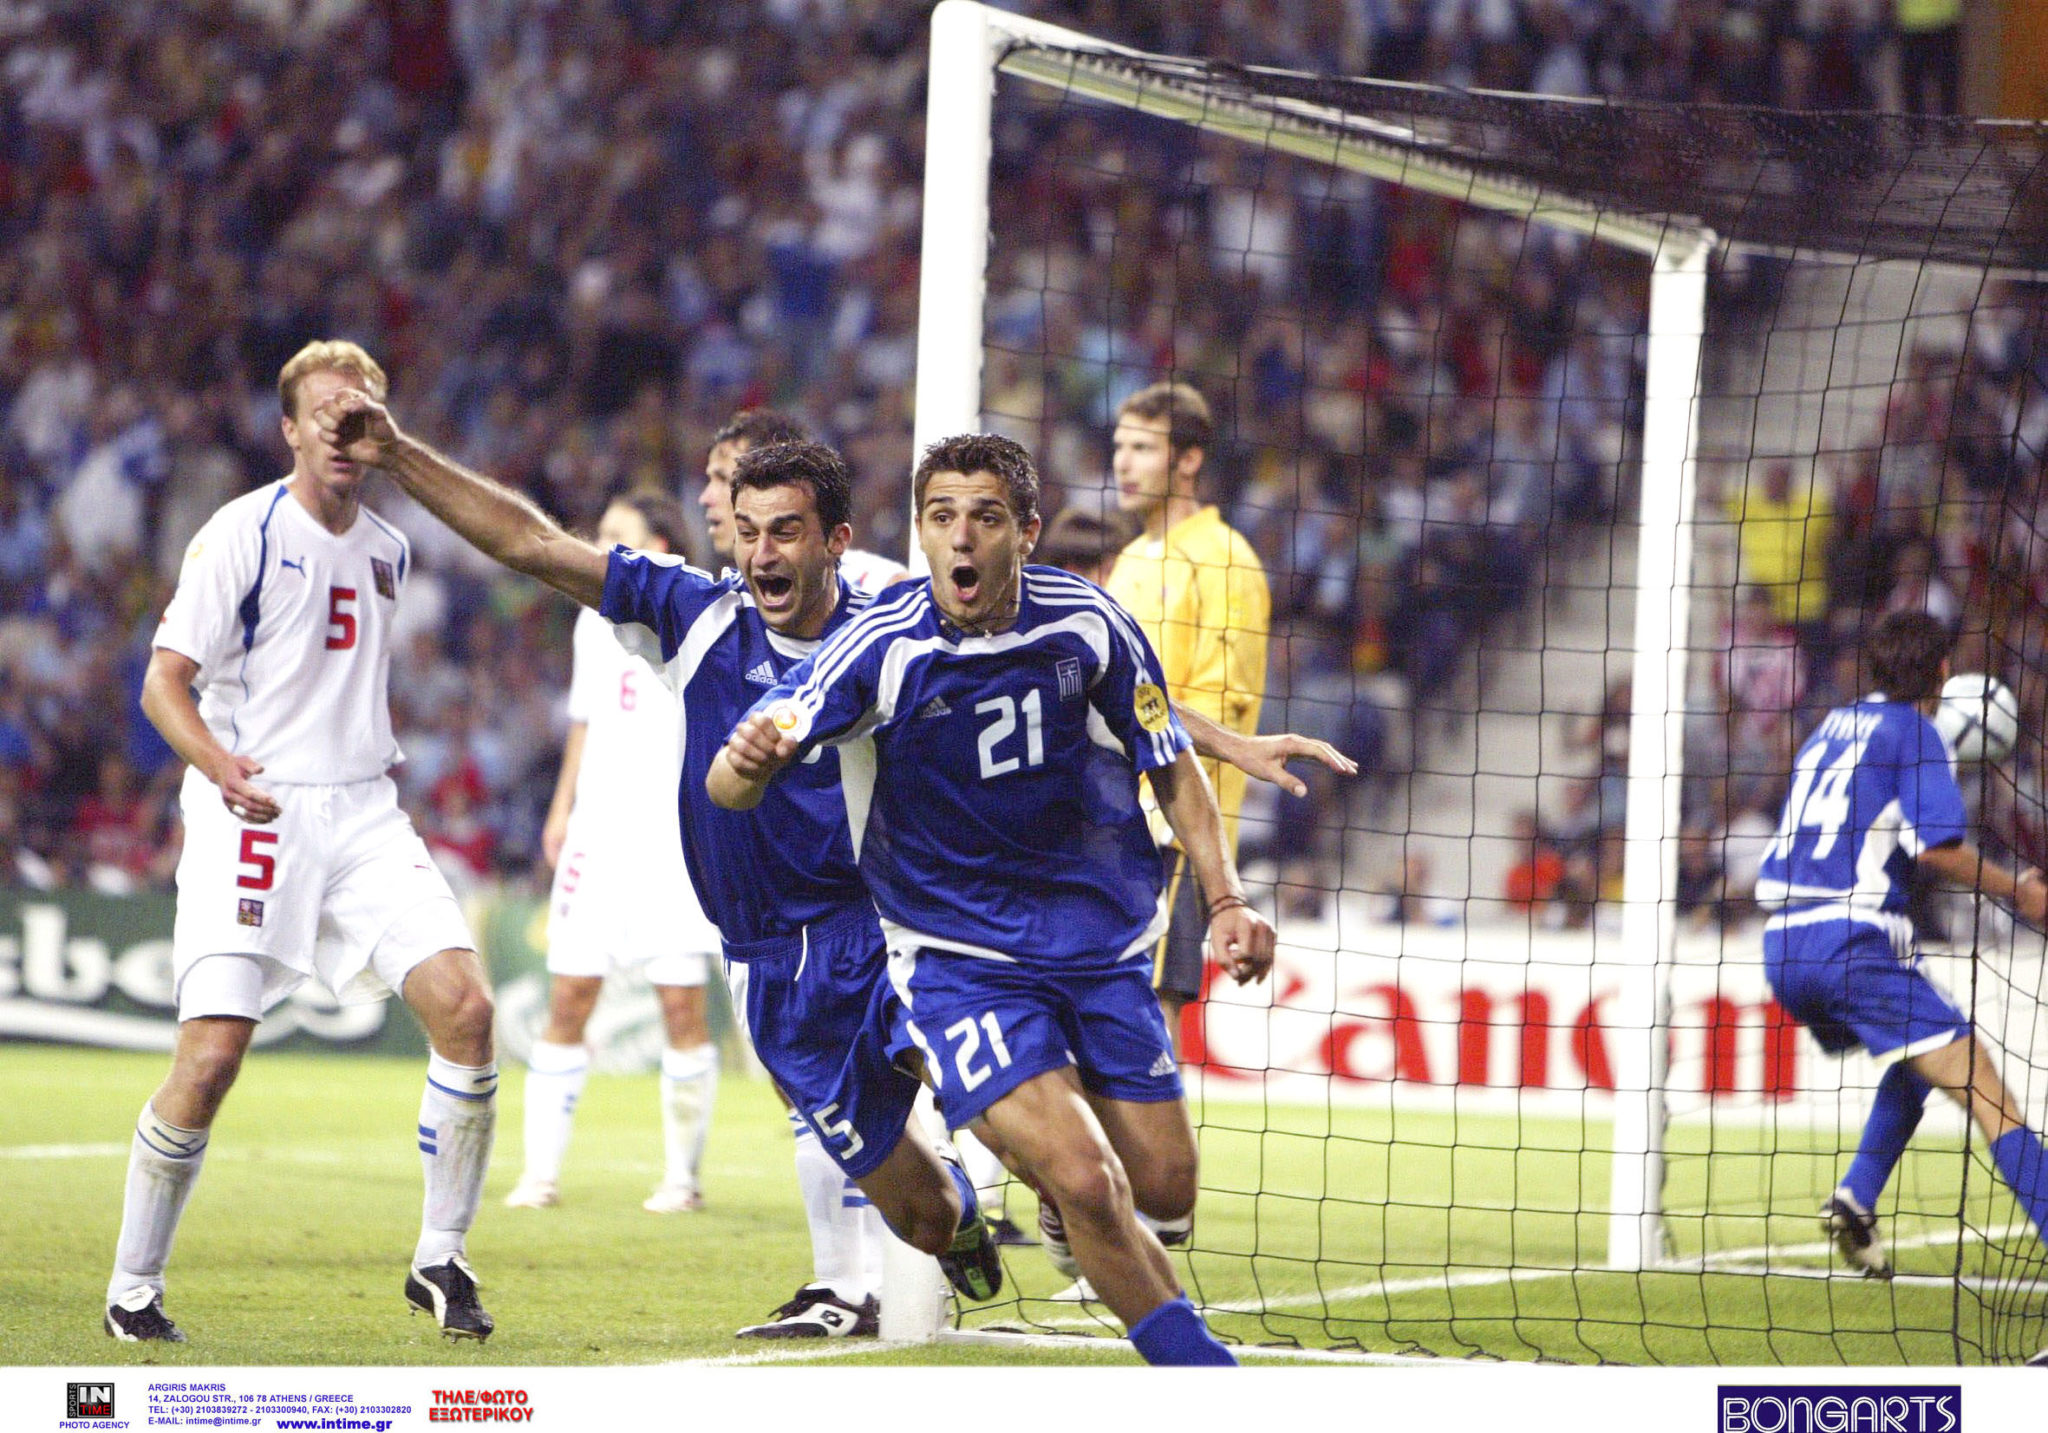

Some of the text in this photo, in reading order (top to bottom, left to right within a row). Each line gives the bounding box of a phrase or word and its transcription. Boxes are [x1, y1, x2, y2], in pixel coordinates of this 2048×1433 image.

[324, 585, 357, 651] 5
[744, 673, 778, 686] adidas
[975, 688, 1044, 780] 21
[1774, 740, 1869, 861] 14
[236, 828, 279, 891] 5
[944, 1010, 1013, 1094] 21
[812, 1102, 865, 1161] 5
